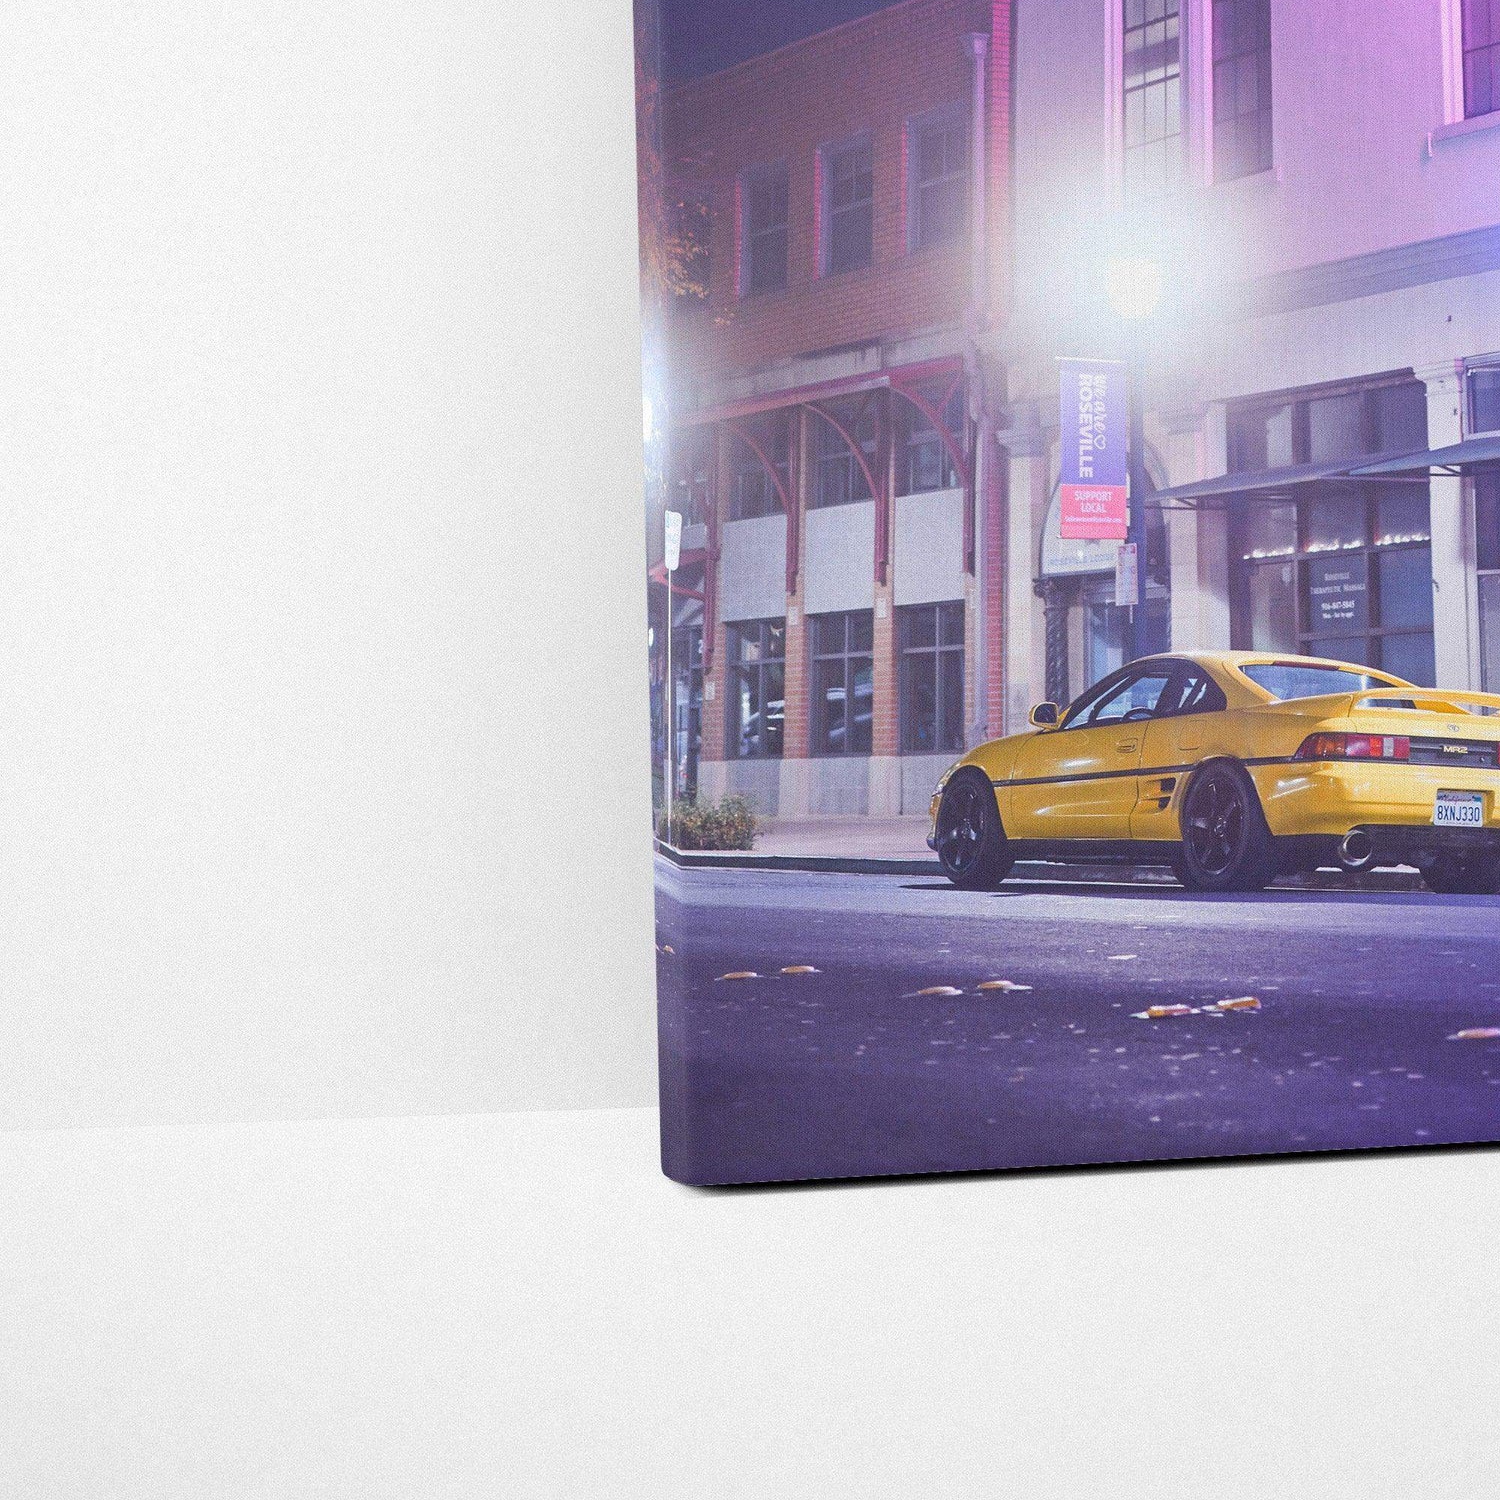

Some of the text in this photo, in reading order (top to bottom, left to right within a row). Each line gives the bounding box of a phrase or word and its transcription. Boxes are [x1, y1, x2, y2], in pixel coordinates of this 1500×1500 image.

[1079, 373, 1094, 478] ROSEVILLE
[1074, 490, 1113, 501] SUPPORT
[1081, 502, 1107, 513] LOCAL
[1443, 745, 1468, 754] MR2
[1437, 805, 1480, 822] 8XNJ330
